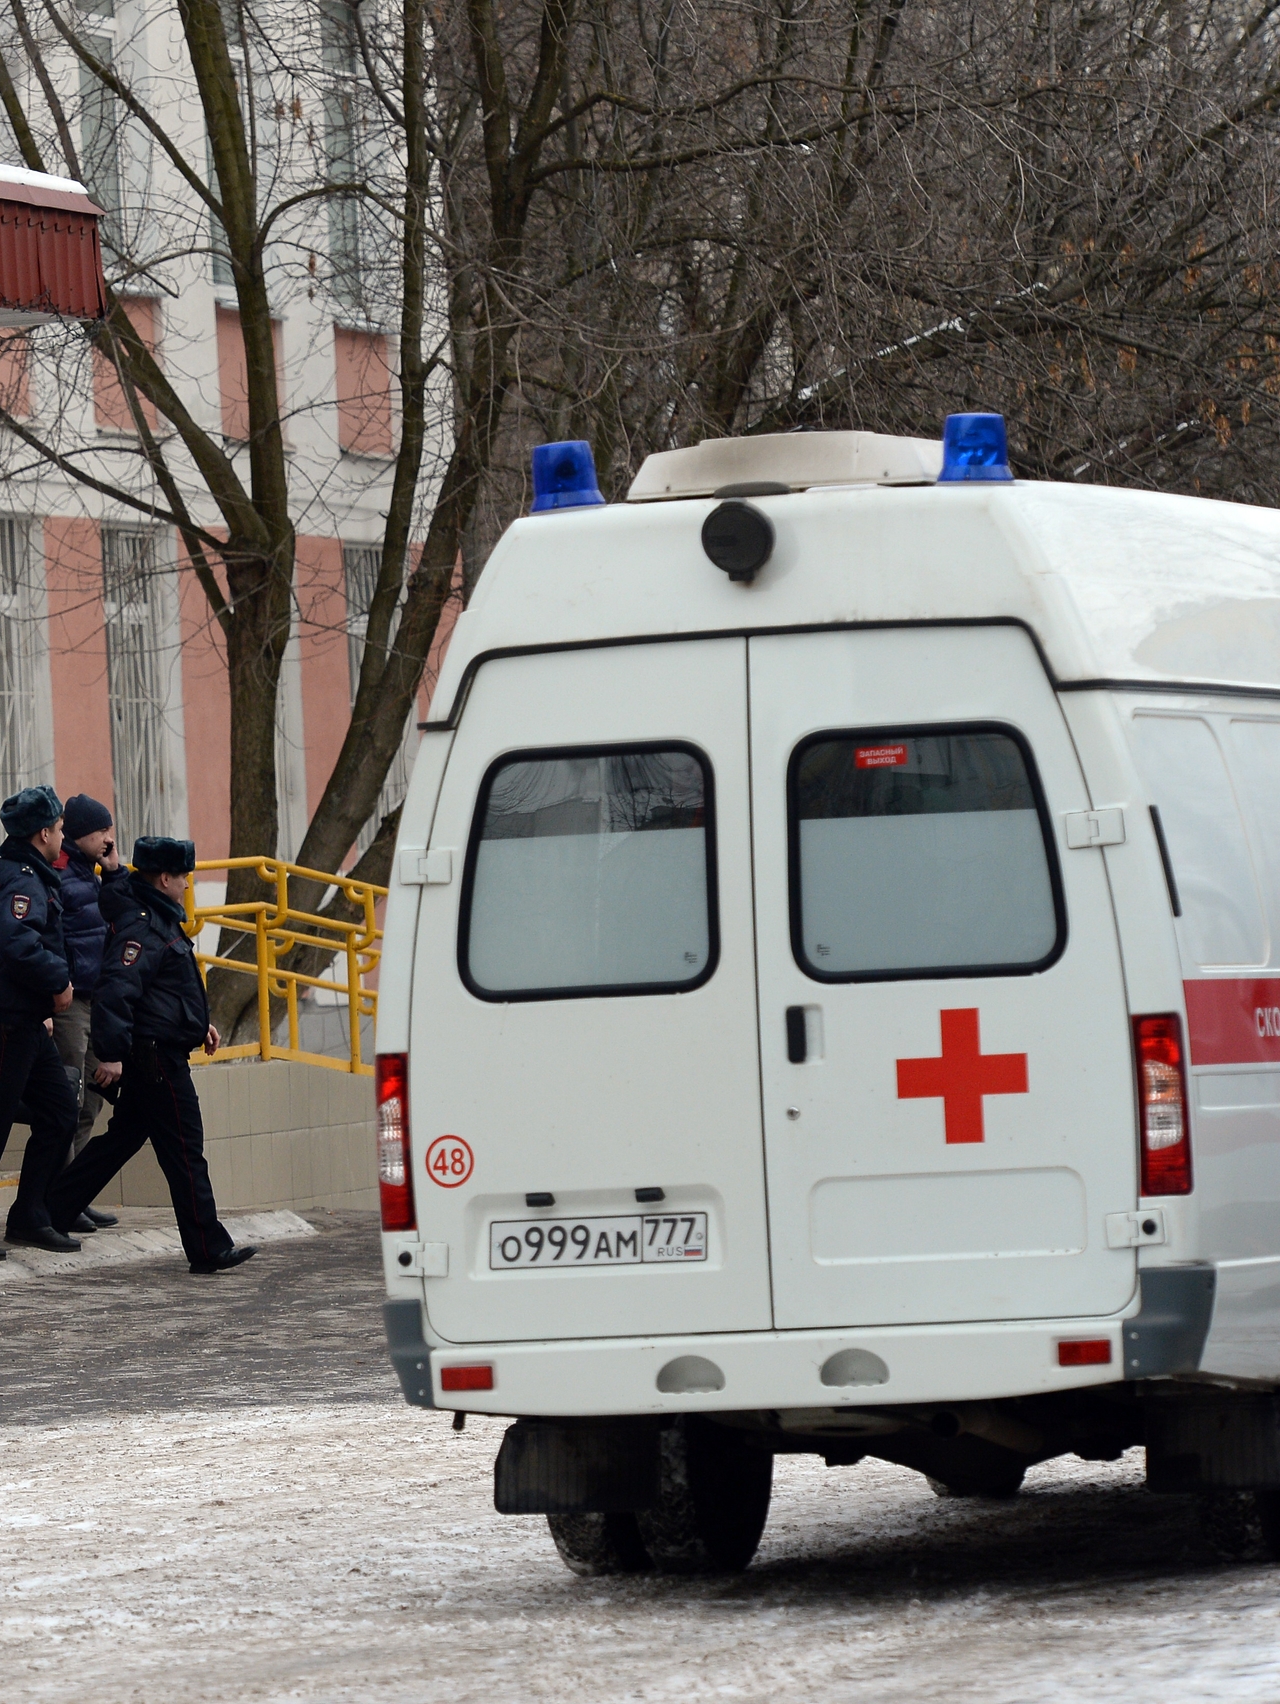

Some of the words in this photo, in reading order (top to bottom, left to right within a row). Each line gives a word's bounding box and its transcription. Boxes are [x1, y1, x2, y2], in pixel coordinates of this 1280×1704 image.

[859, 746, 904, 758] ЗАПАСНЫЙ
[867, 756, 897, 765] ВЫХОД
[433, 1148, 466, 1176] 48
[645, 1217, 696, 1246] 777
[657, 1246, 684, 1258] RUS
